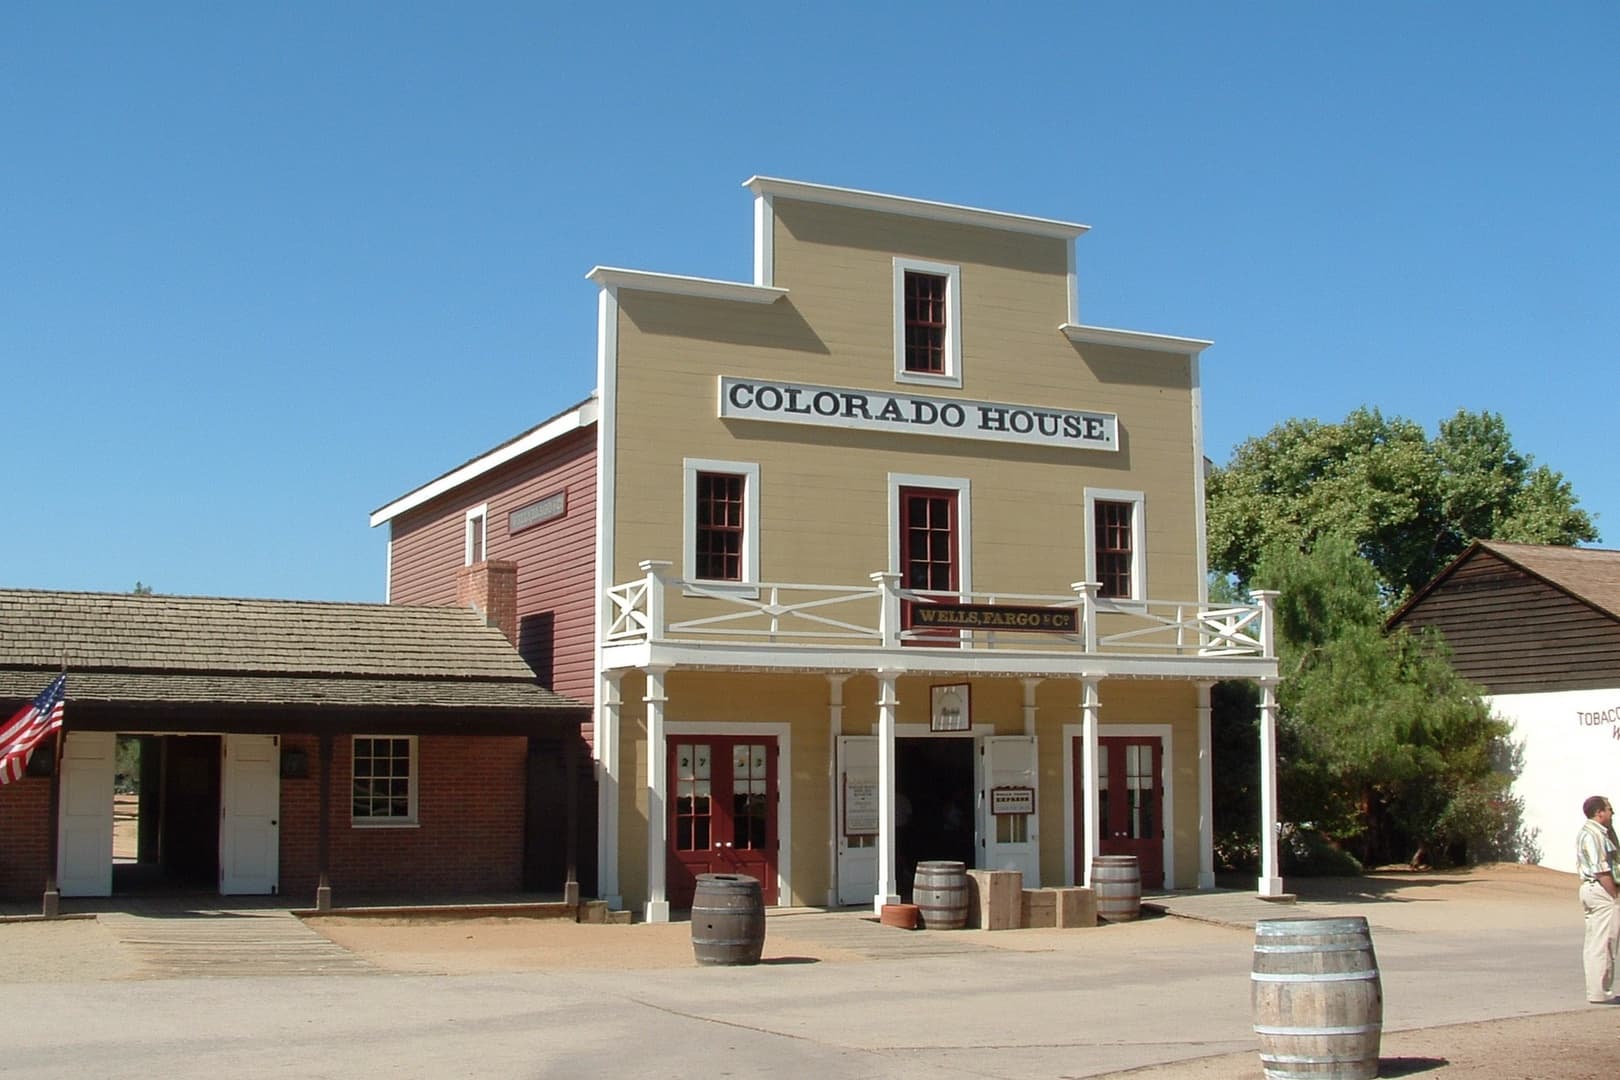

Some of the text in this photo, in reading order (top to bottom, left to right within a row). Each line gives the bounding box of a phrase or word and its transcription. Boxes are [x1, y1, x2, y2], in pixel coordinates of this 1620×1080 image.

[729, 383, 1111, 442] COLORADO HOUSE.
[983, 611, 1041, 626] FARGO
